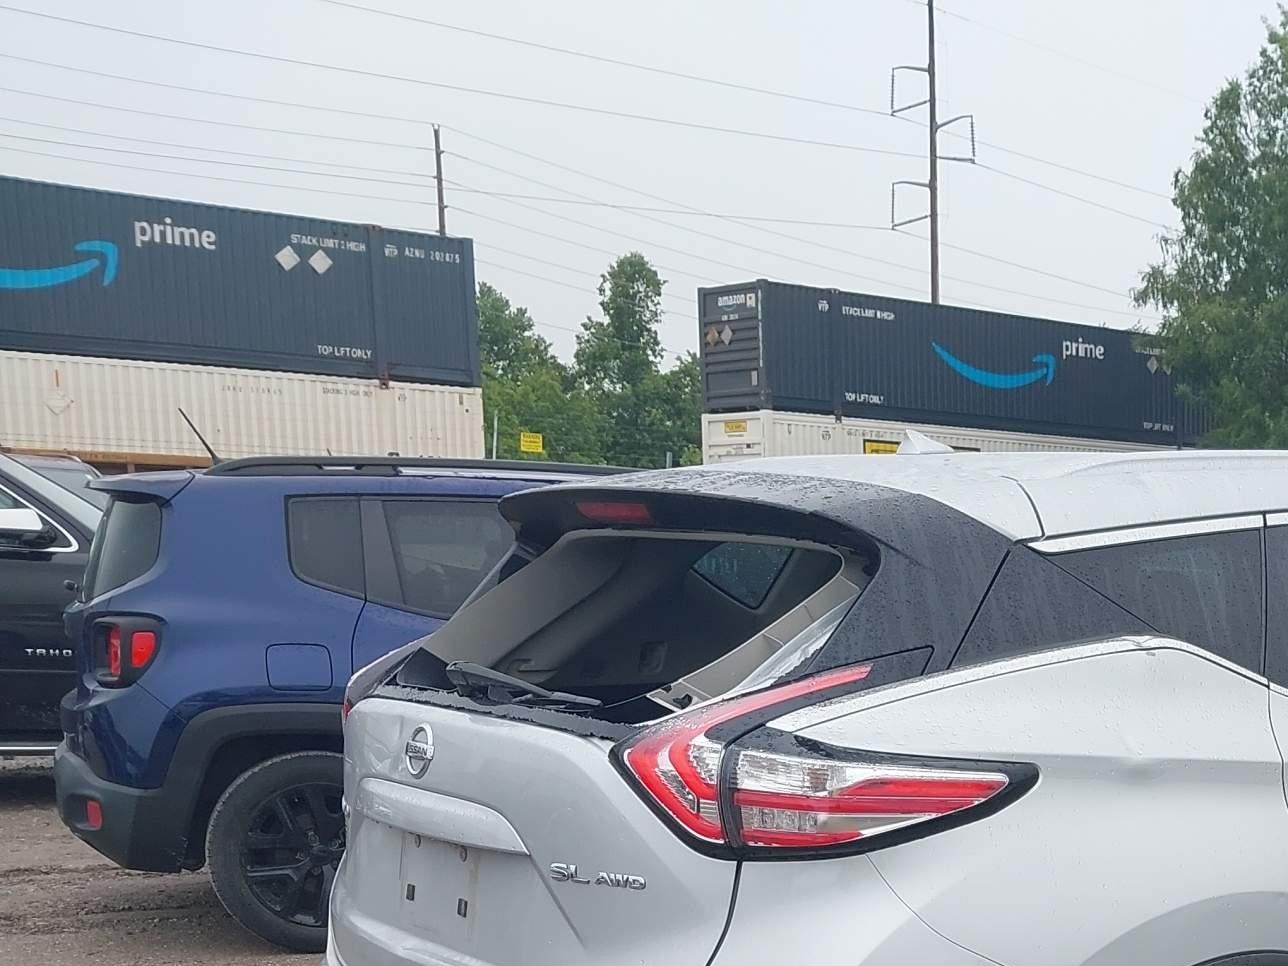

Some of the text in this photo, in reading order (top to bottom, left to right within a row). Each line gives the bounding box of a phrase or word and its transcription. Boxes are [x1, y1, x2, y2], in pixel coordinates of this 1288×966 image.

[134, 217, 216, 250] prime
[718, 294, 745, 306] amazon
[1062, 337, 1105, 360] prime
[24, 648, 73, 657] TAHO
[550, 862, 647, 890] SL AWD
